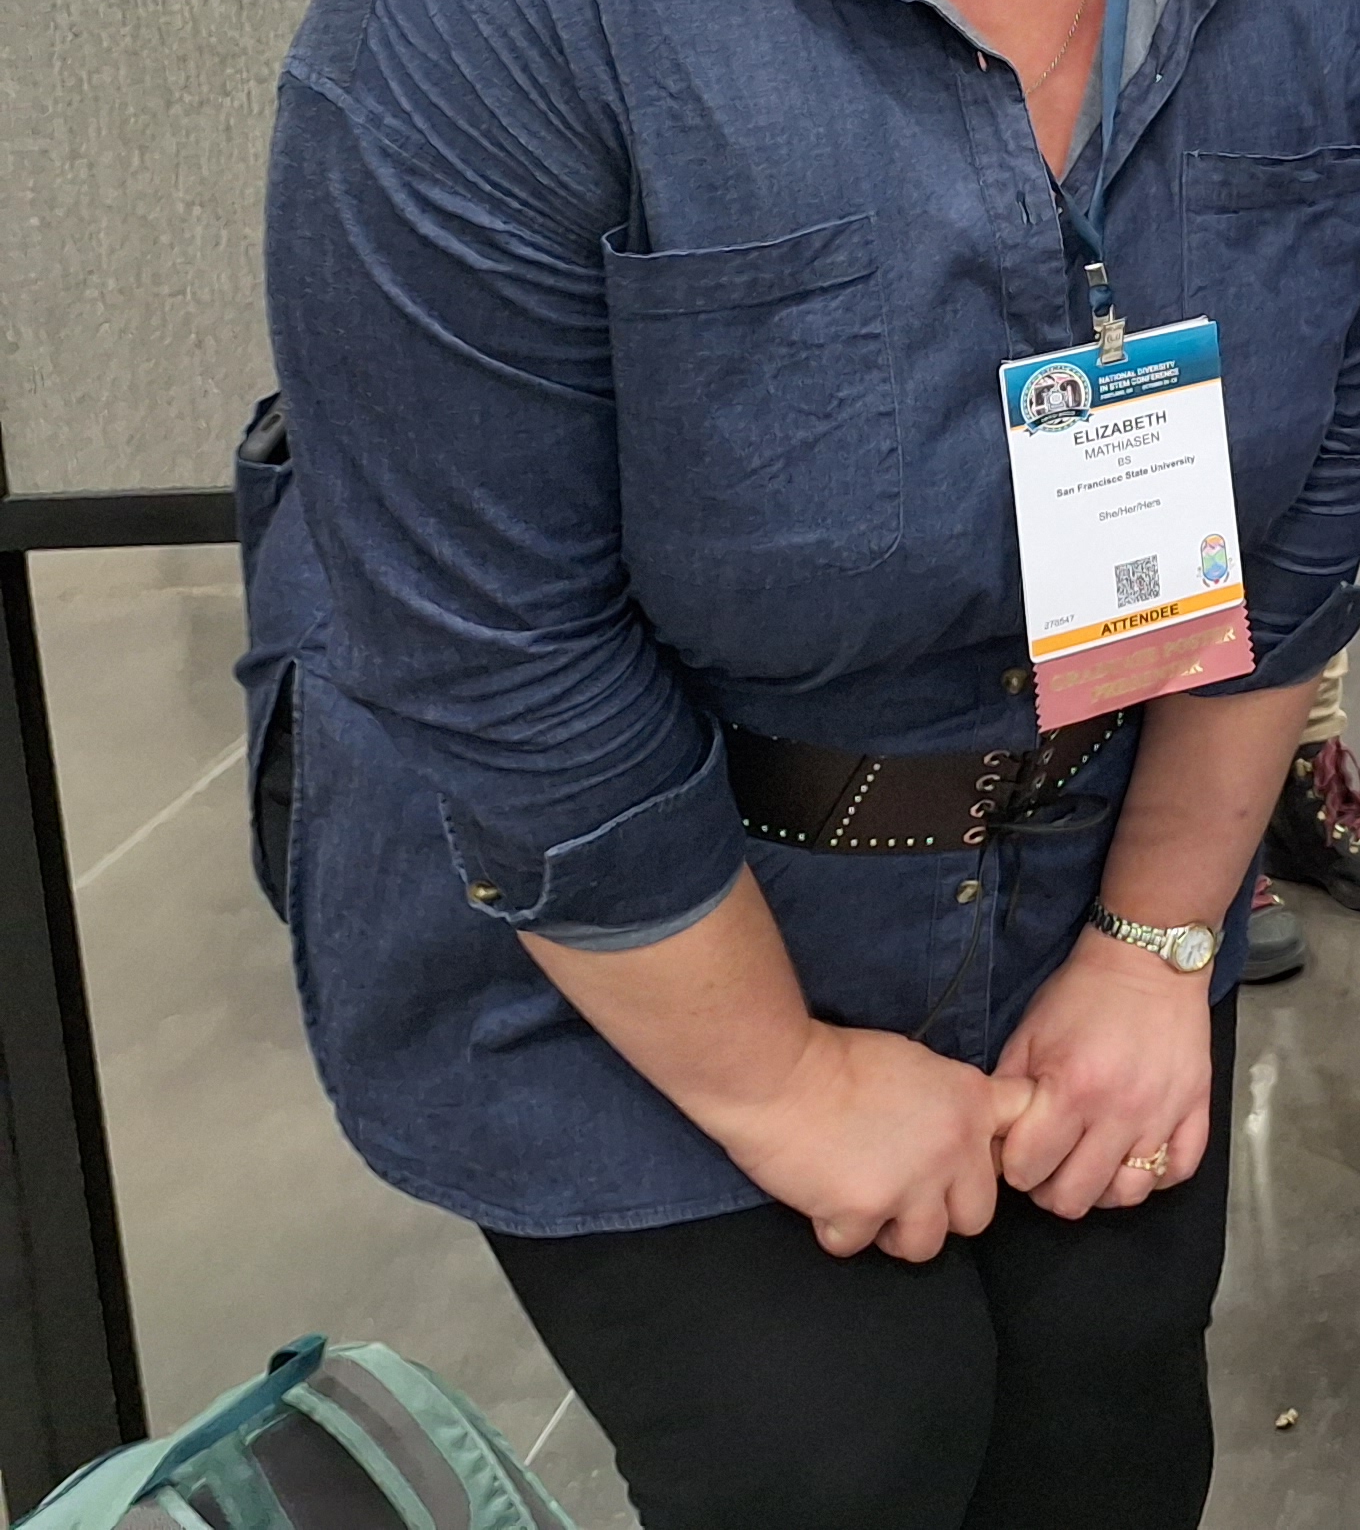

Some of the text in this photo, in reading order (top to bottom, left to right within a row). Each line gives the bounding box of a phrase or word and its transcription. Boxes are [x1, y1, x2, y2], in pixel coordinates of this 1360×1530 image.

[1074, 410, 1168, 445] ELIZABETH
[1085, 431, 1161, 460] MATHIASEN
[1057, 455, 1196, 497] San Francisco State University
[1101, 603, 1180, 636] ATTENDEE
